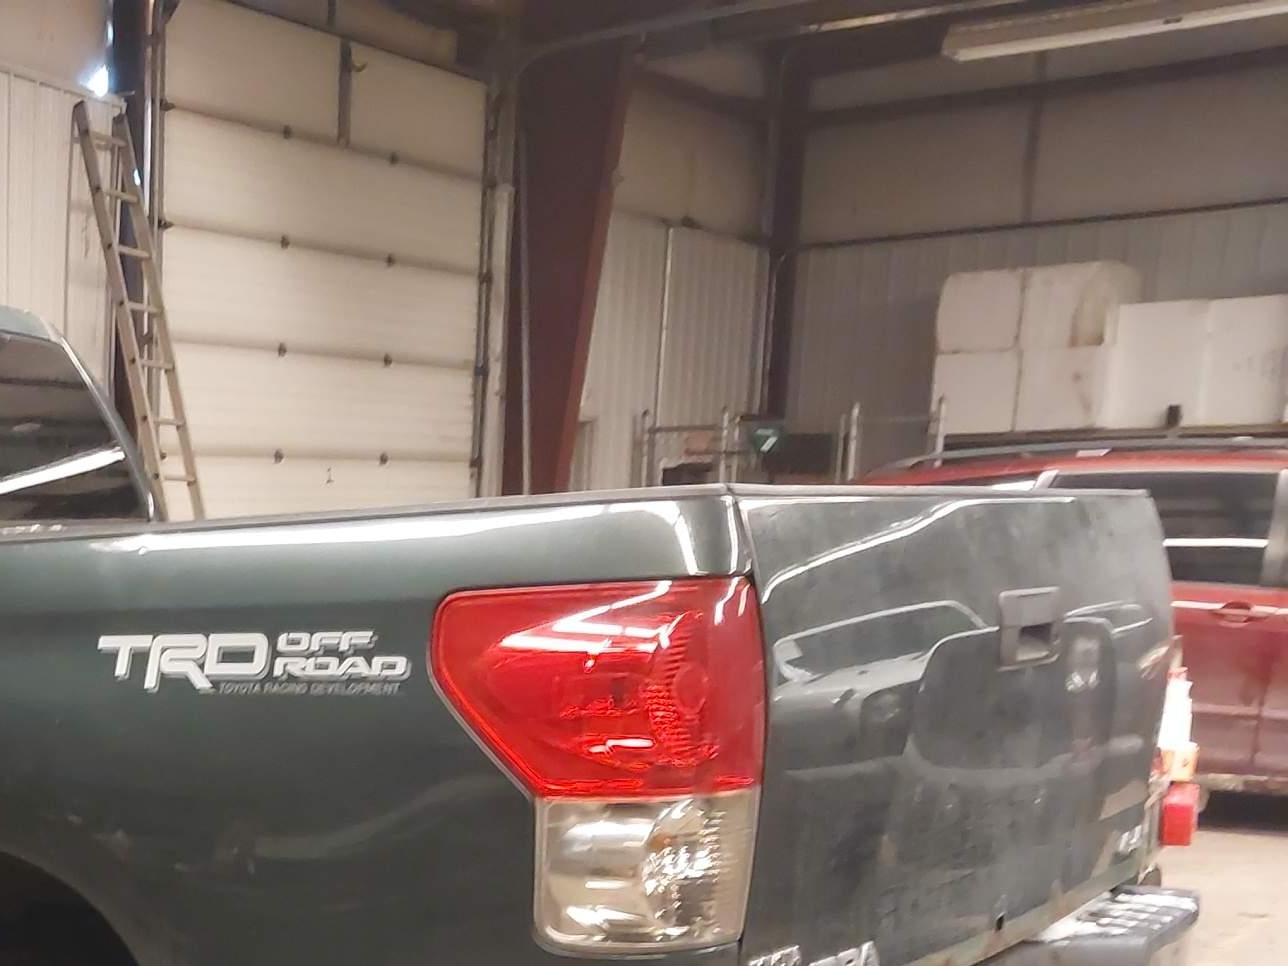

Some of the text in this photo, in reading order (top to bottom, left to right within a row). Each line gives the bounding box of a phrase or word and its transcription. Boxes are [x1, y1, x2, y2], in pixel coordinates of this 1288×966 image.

[276, 630, 378, 656] OFF
[98, 632, 272, 693] TRD
[273, 655, 413, 681] ROAD
[219, 682, 261, 695] TOYOTA
